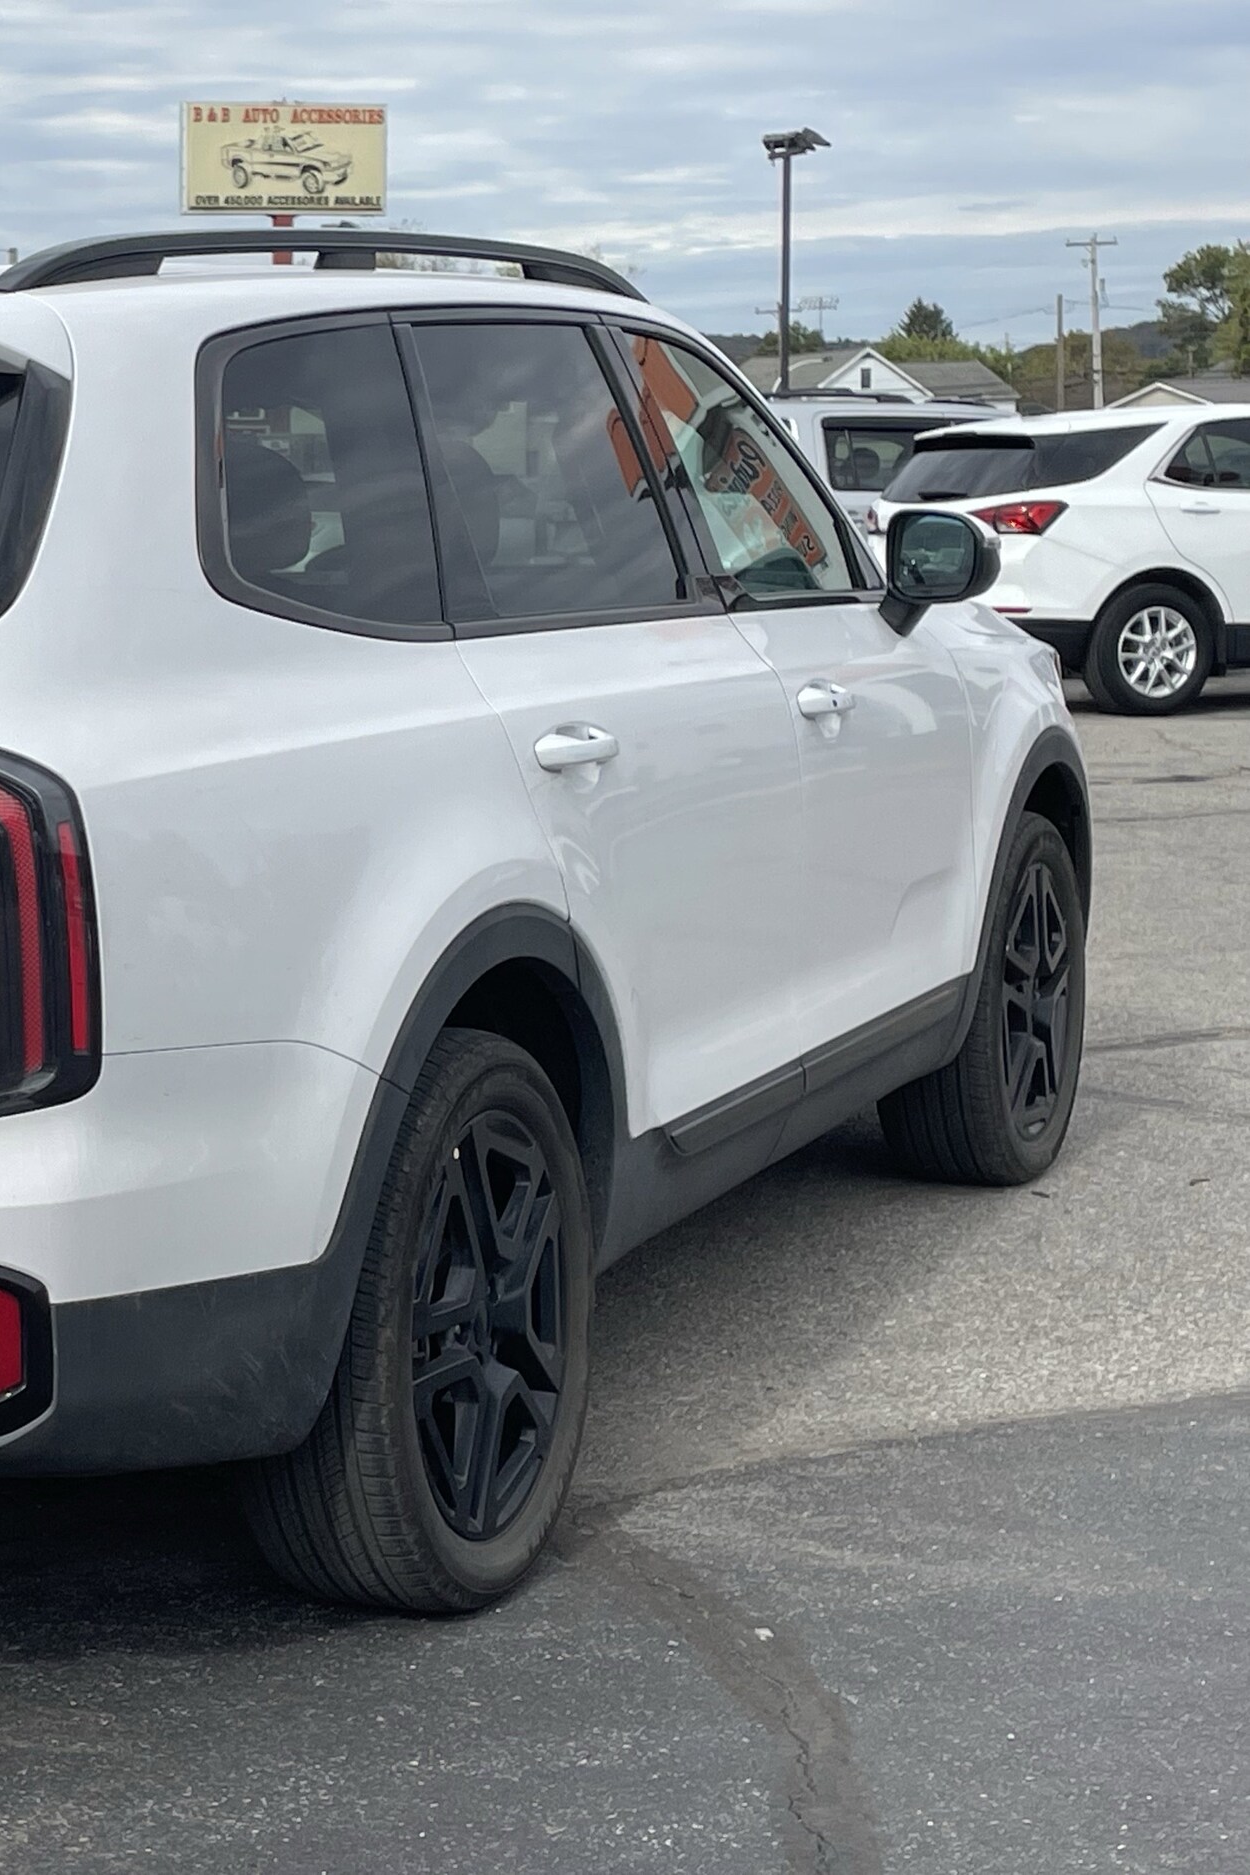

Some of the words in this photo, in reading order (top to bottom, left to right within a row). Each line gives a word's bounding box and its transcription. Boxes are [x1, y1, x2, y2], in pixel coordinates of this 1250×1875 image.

[193, 106, 203, 123] B
[207, 105, 218, 123] &
[221, 106, 230, 123] B
[242, 107, 280, 124] AUTO
[290, 107, 384, 124] ACCESSORIES
[195, 195, 219, 206] OVER
[267, 195, 329, 206] ACCESSORIES
[333, 195, 382, 206] AVAILABLE
